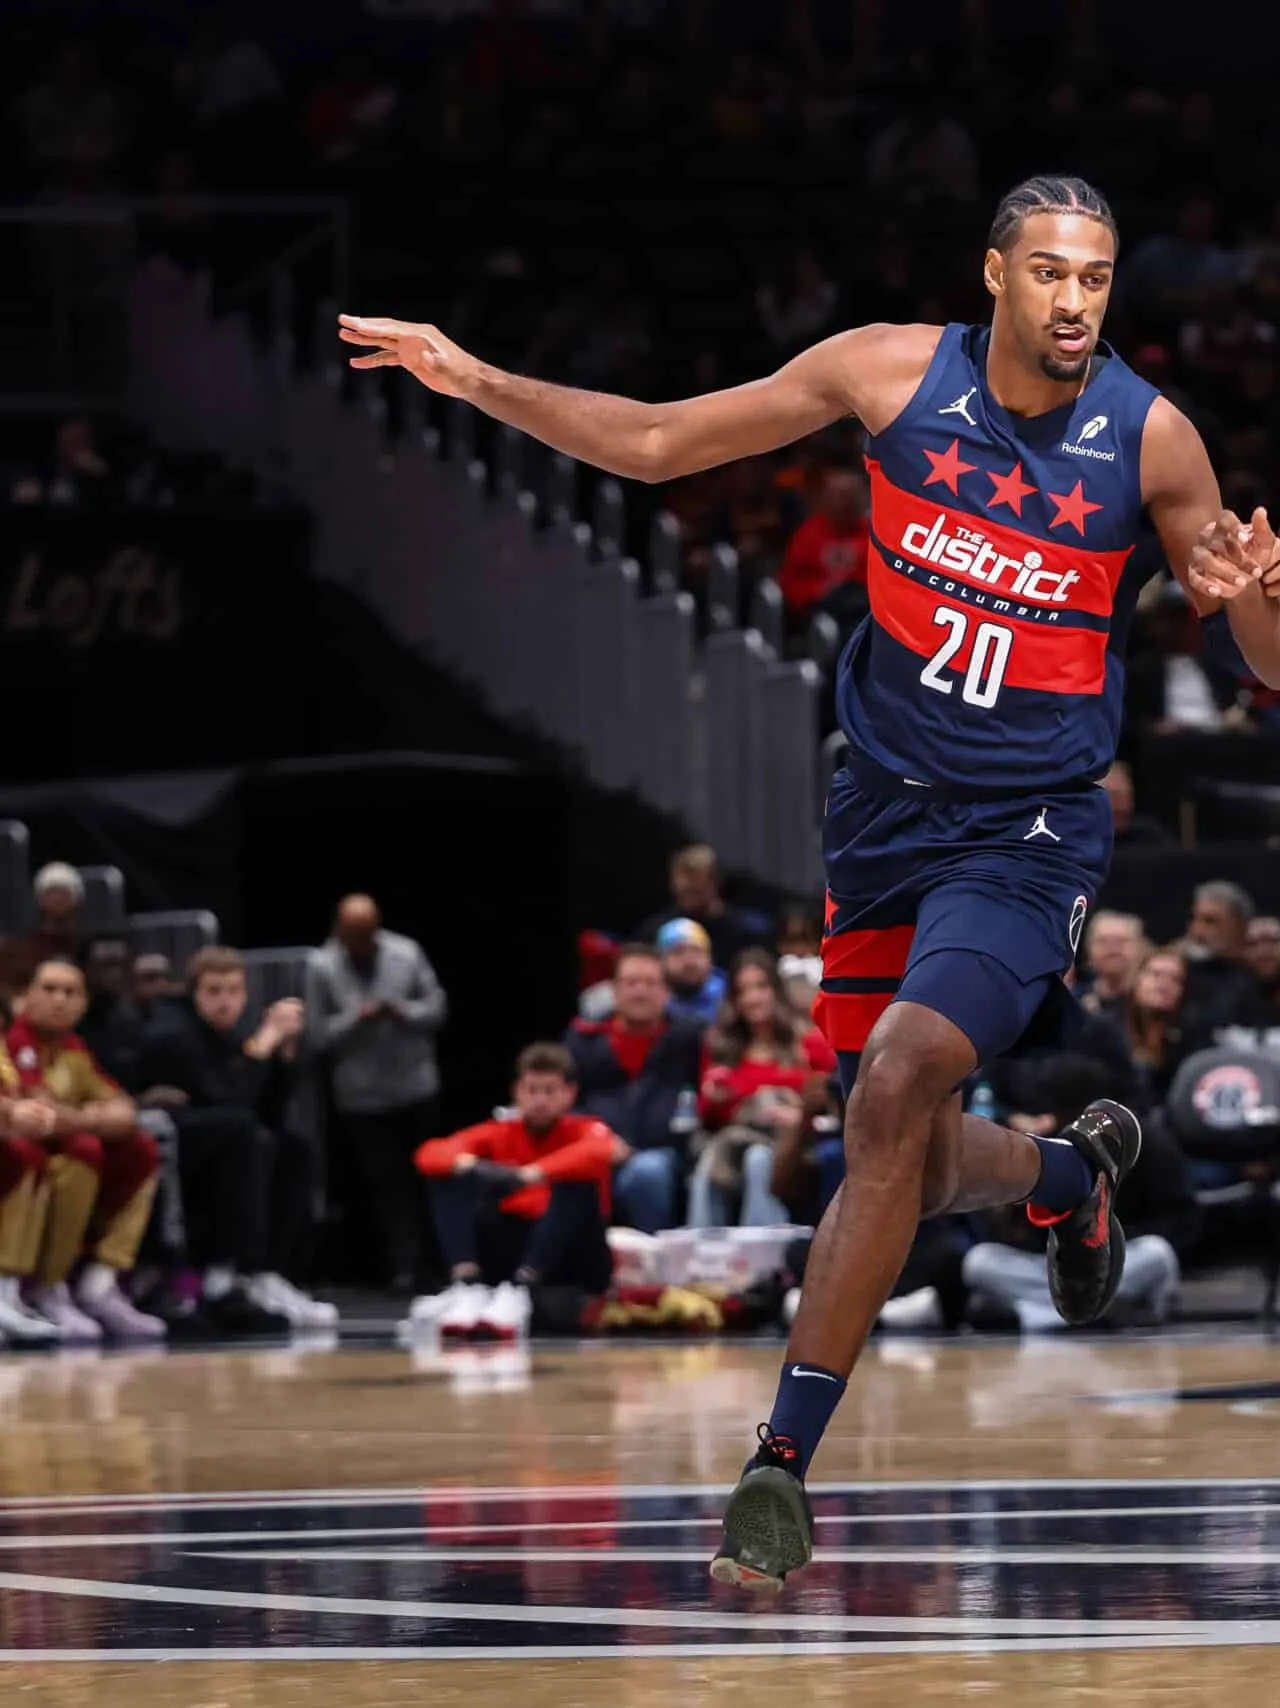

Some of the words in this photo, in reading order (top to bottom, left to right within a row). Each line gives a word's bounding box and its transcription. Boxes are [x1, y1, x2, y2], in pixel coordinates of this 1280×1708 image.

[1062, 442, 1115, 461] Robinhood
[901, 512, 1081, 602] district
[956, 526, 985, 545] THE
[920, 606, 1014, 709] 20
